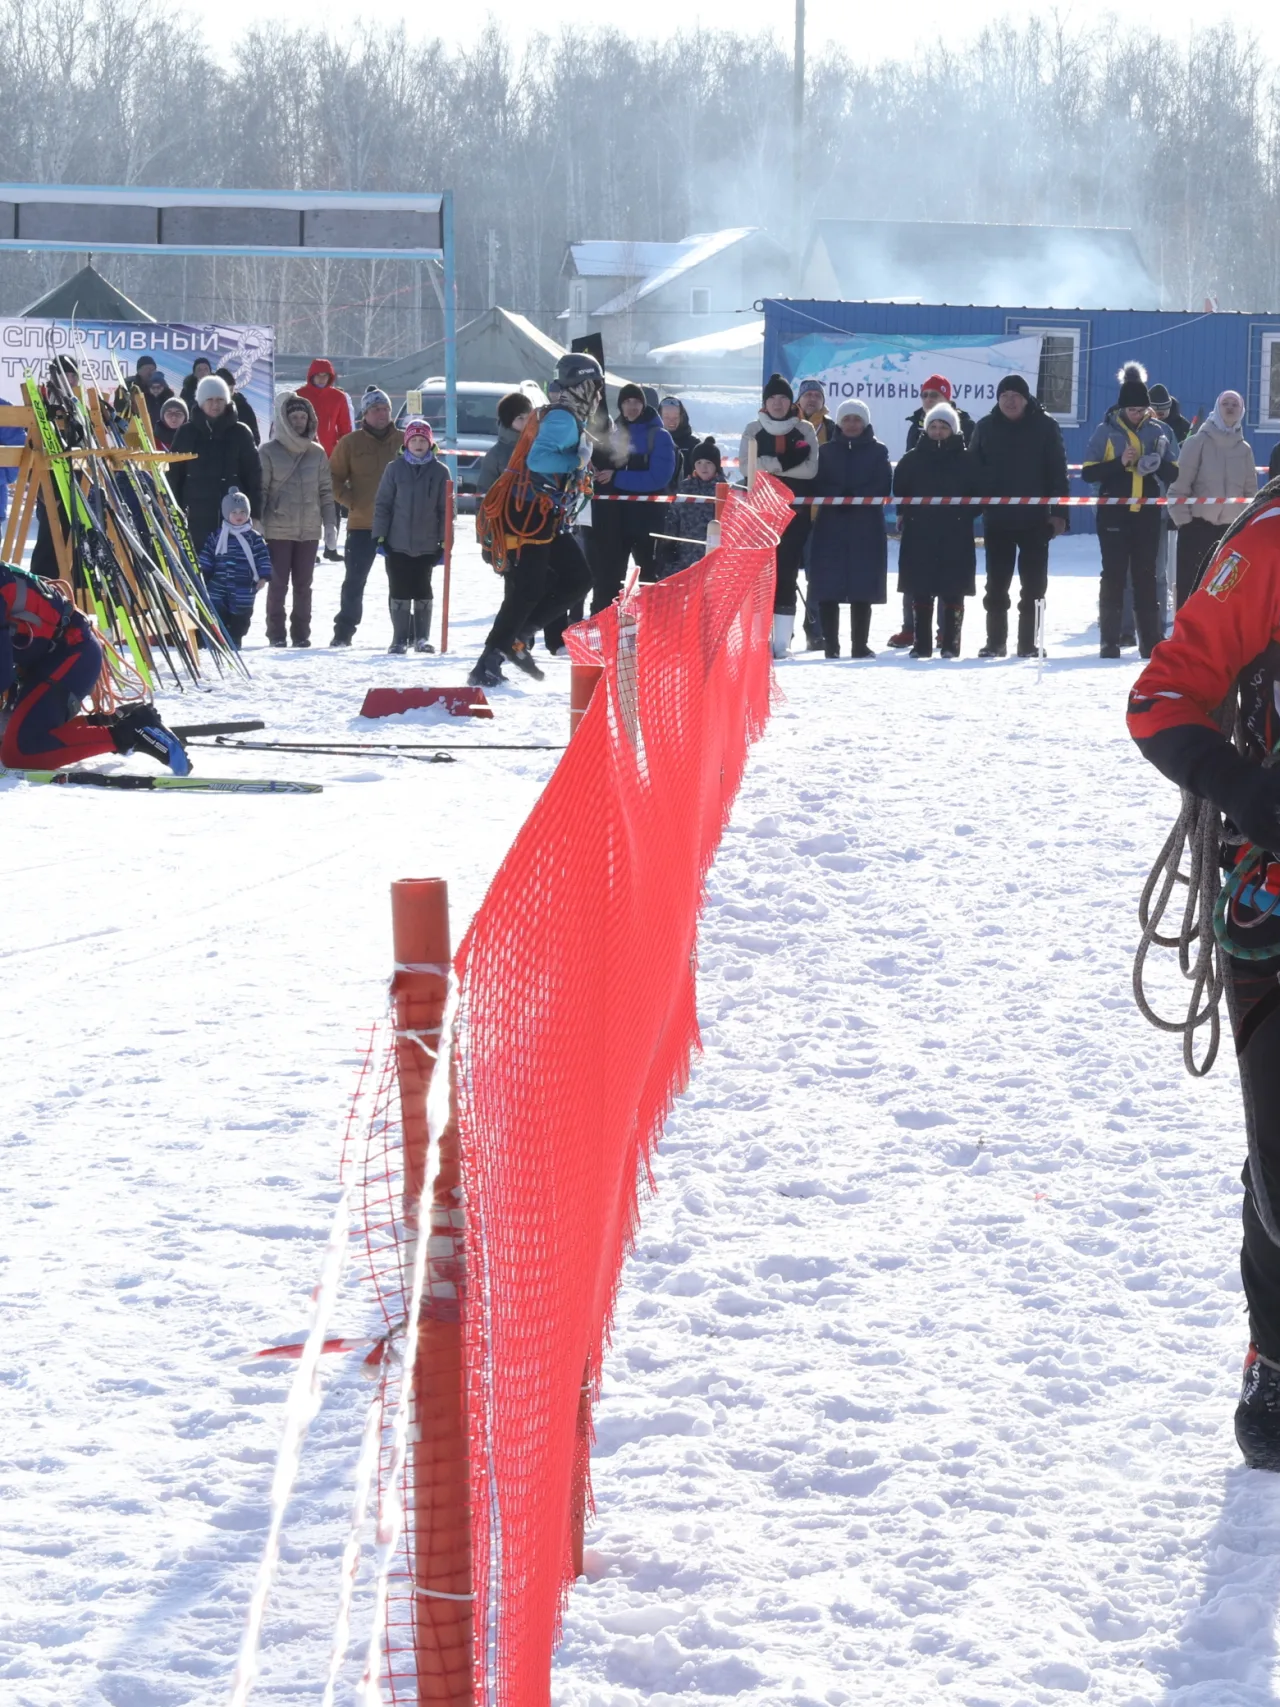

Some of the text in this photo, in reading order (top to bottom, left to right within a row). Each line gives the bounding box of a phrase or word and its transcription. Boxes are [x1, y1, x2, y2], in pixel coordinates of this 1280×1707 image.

[3, 325, 220, 351] СПОРТИВНЫЙ
[2, 357, 128, 381] ТУРЗМ
[952, 384, 996, 400] УРИЗ
